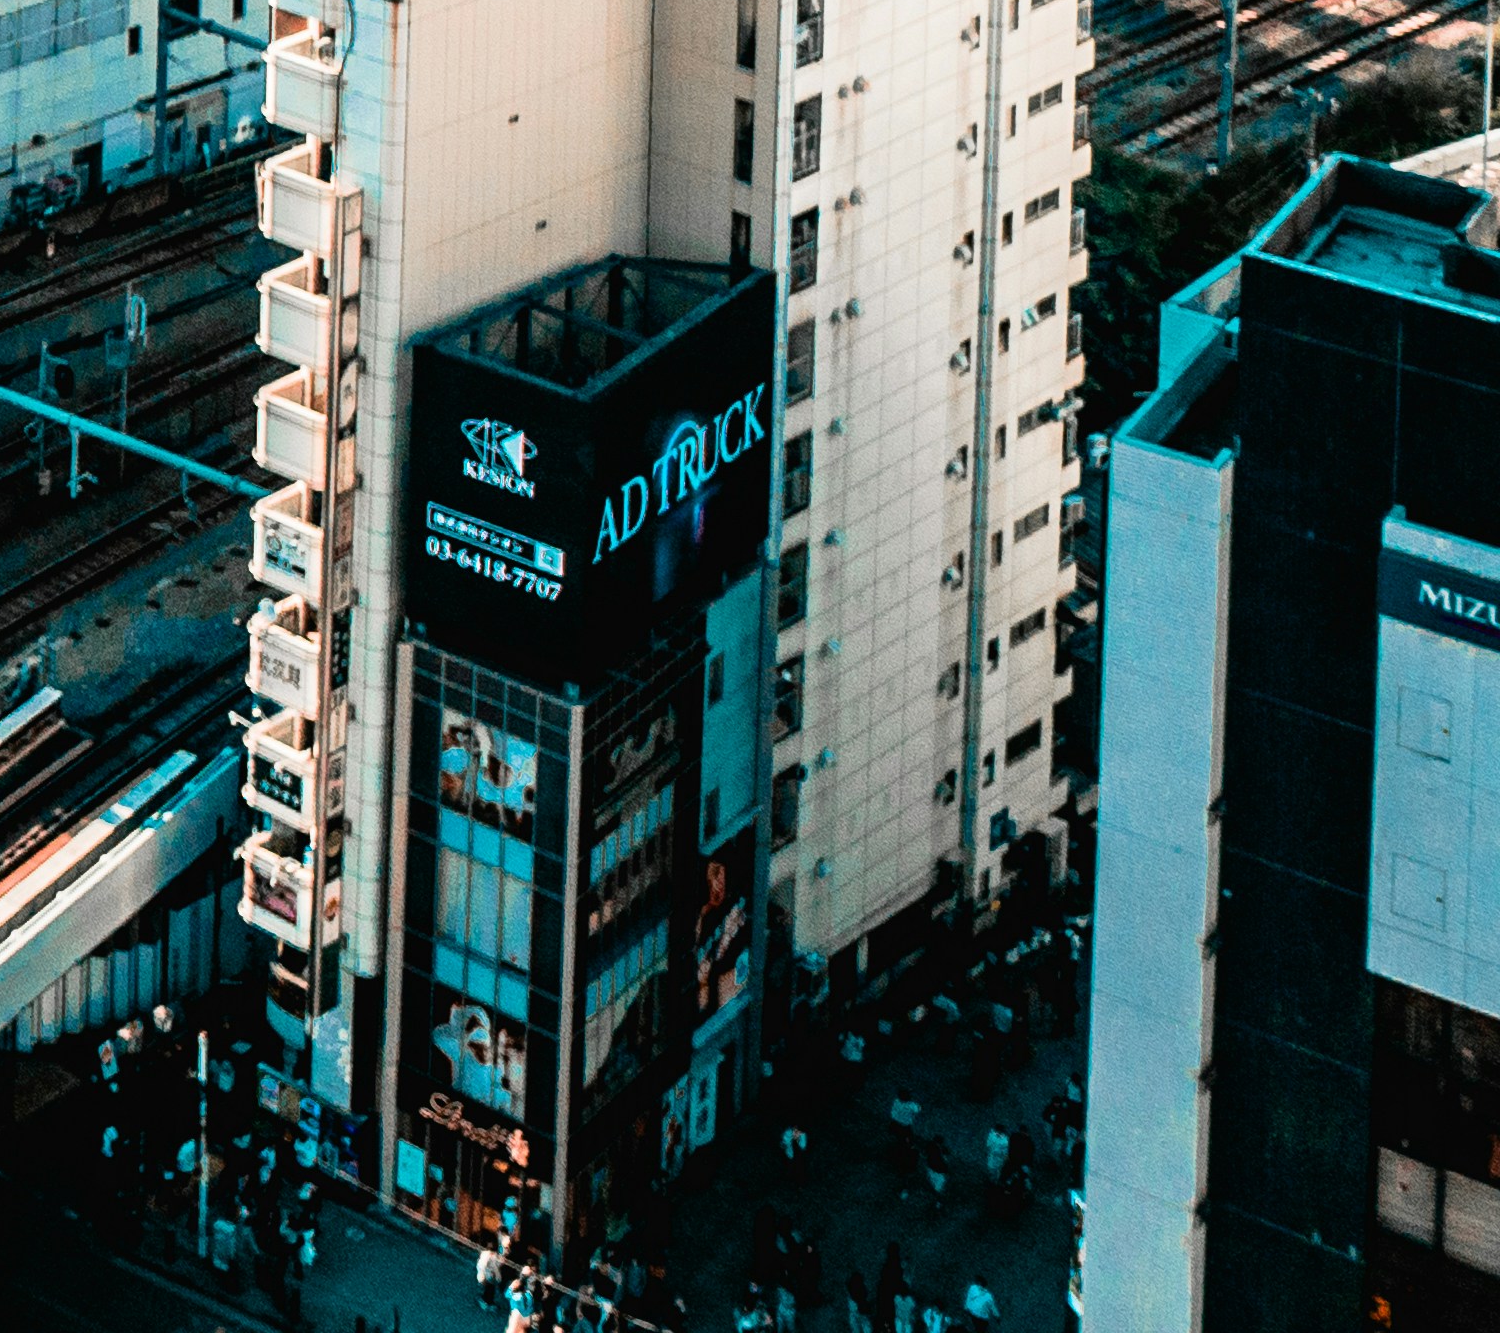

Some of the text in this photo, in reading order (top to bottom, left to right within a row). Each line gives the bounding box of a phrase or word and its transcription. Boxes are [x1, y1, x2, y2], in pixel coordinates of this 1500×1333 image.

[592, 381, 767, 565] AD TRUCK
[425, 536, 564, 601] 03-6418-7707
